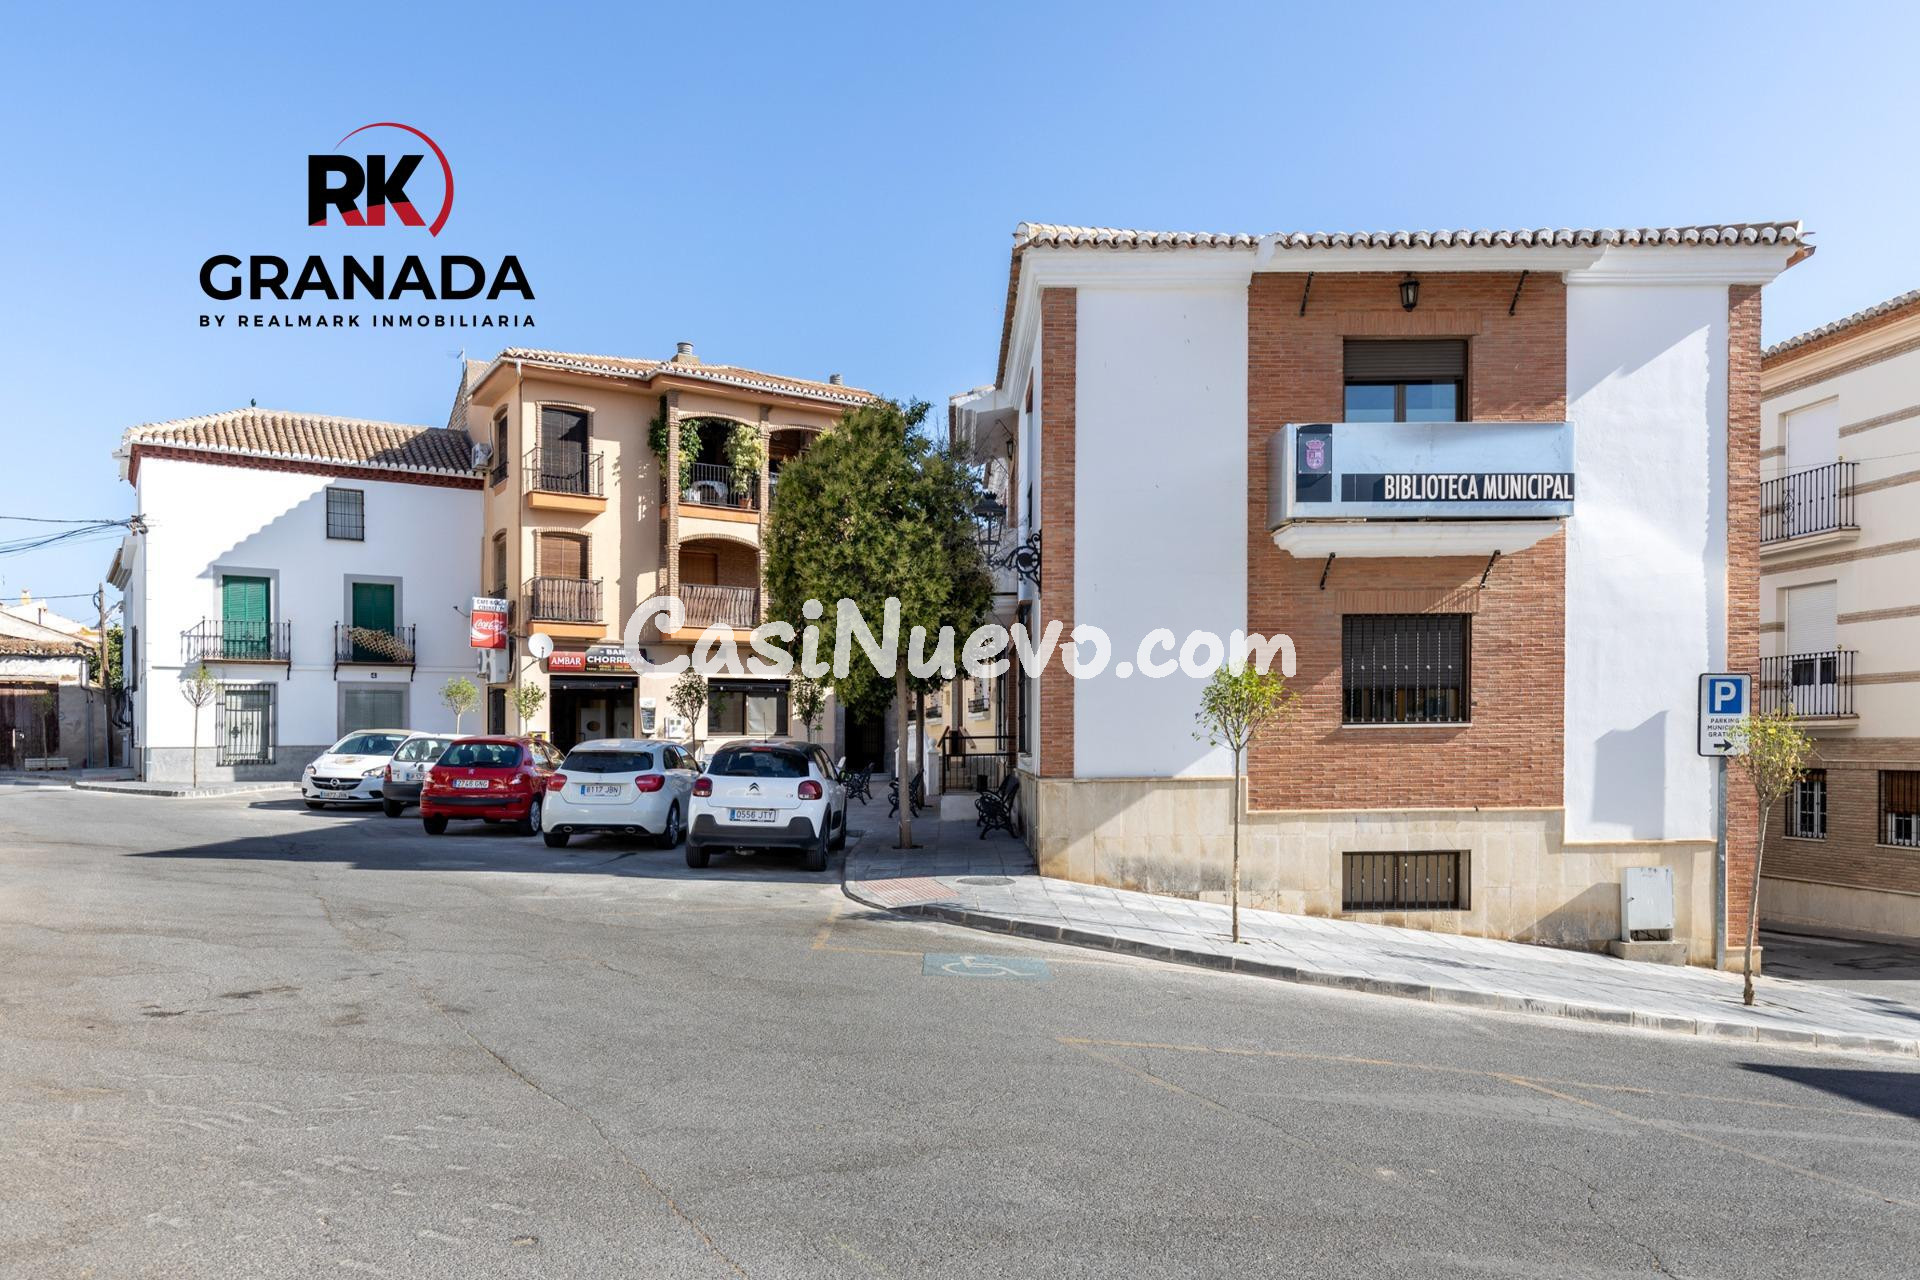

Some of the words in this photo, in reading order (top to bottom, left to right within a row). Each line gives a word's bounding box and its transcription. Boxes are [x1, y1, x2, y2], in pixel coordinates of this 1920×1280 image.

[1384, 474, 1479, 500] BIBLIOTECA
[1483, 474, 1573, 500] MUNICIPAL
[551, 656, 581, 665] AMBAR
[1714, 681, 1737, 711] P
[758, 811, 773, 819] JTY
